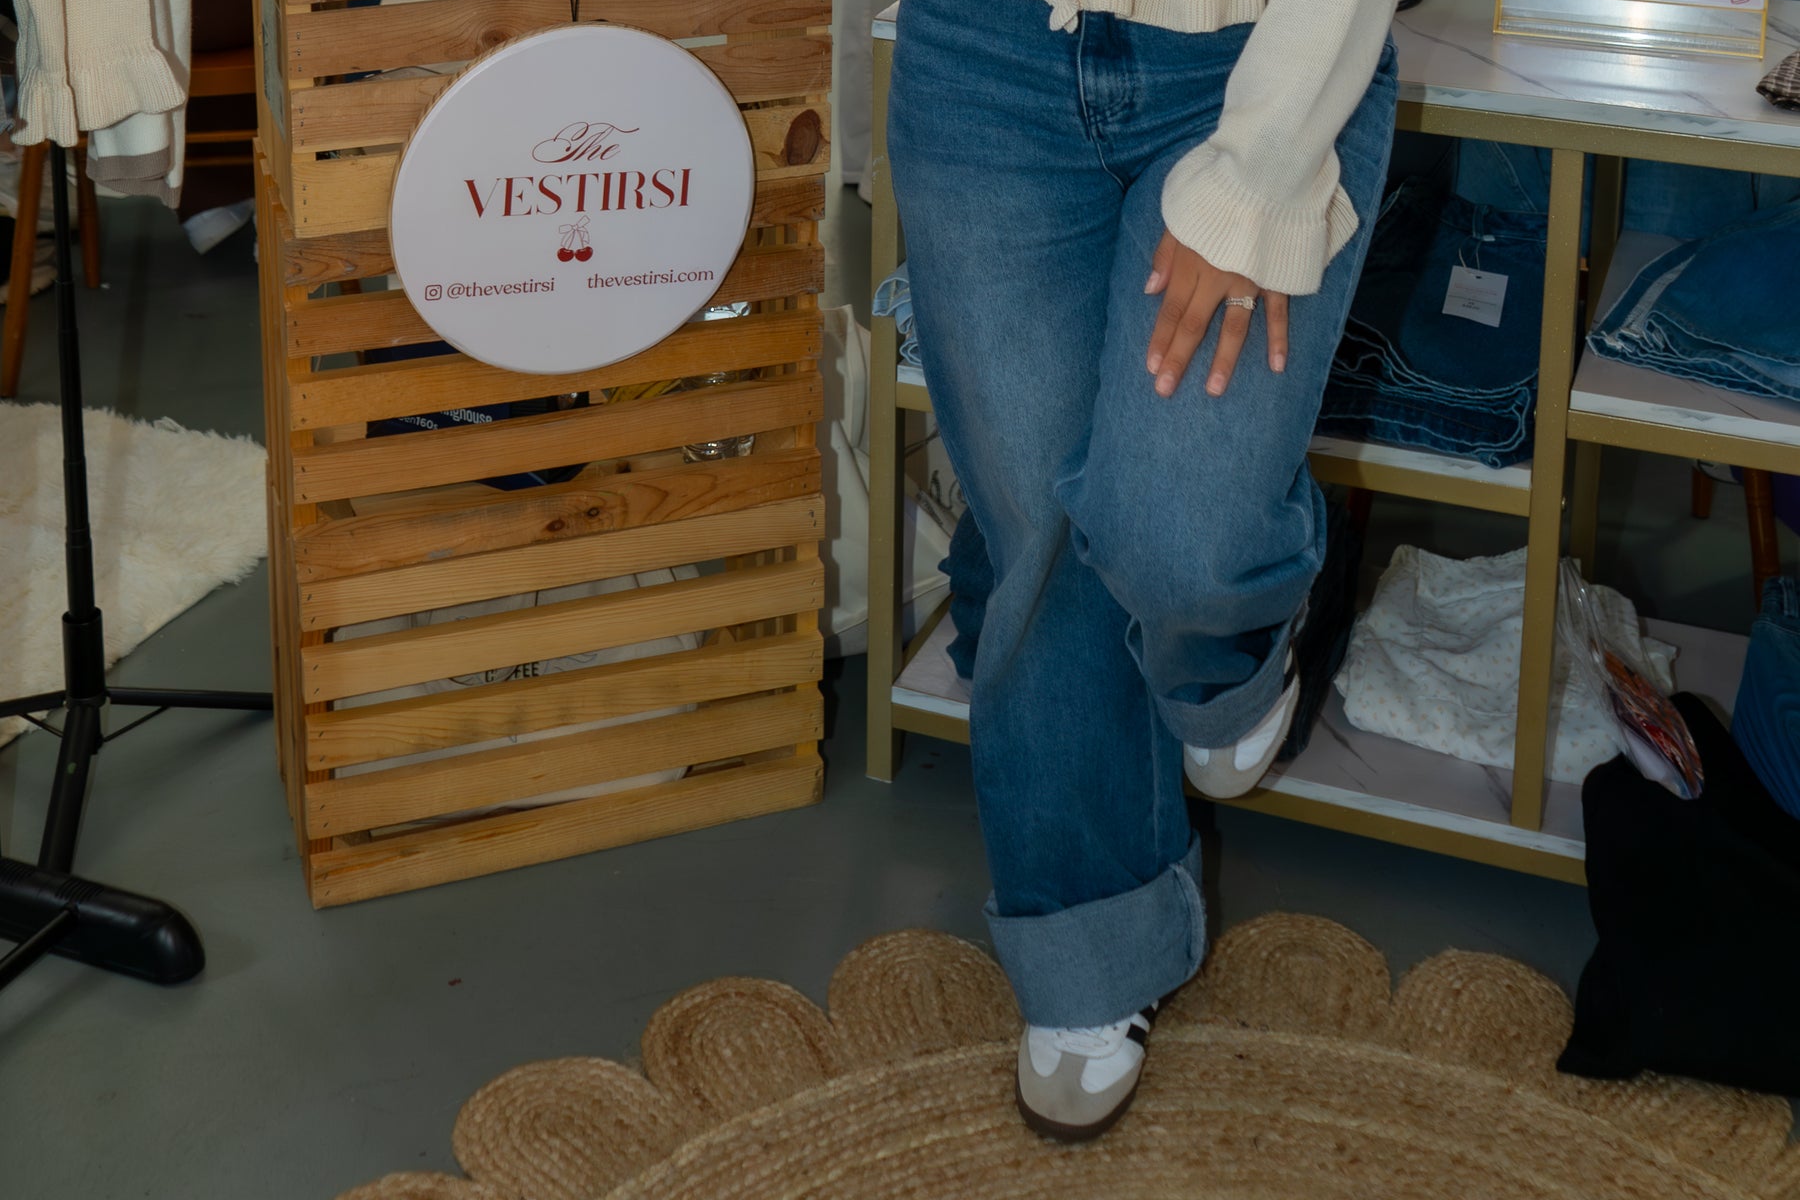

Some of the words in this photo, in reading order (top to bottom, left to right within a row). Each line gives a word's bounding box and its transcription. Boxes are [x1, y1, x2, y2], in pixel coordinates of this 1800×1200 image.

[532, 121, 640, 163] The
[463, 168, 692, 219] VESTIRSI
[447, 277, 556, 300] @thevestirsi
[587, 268, 714, 290] thevestirsi.com
